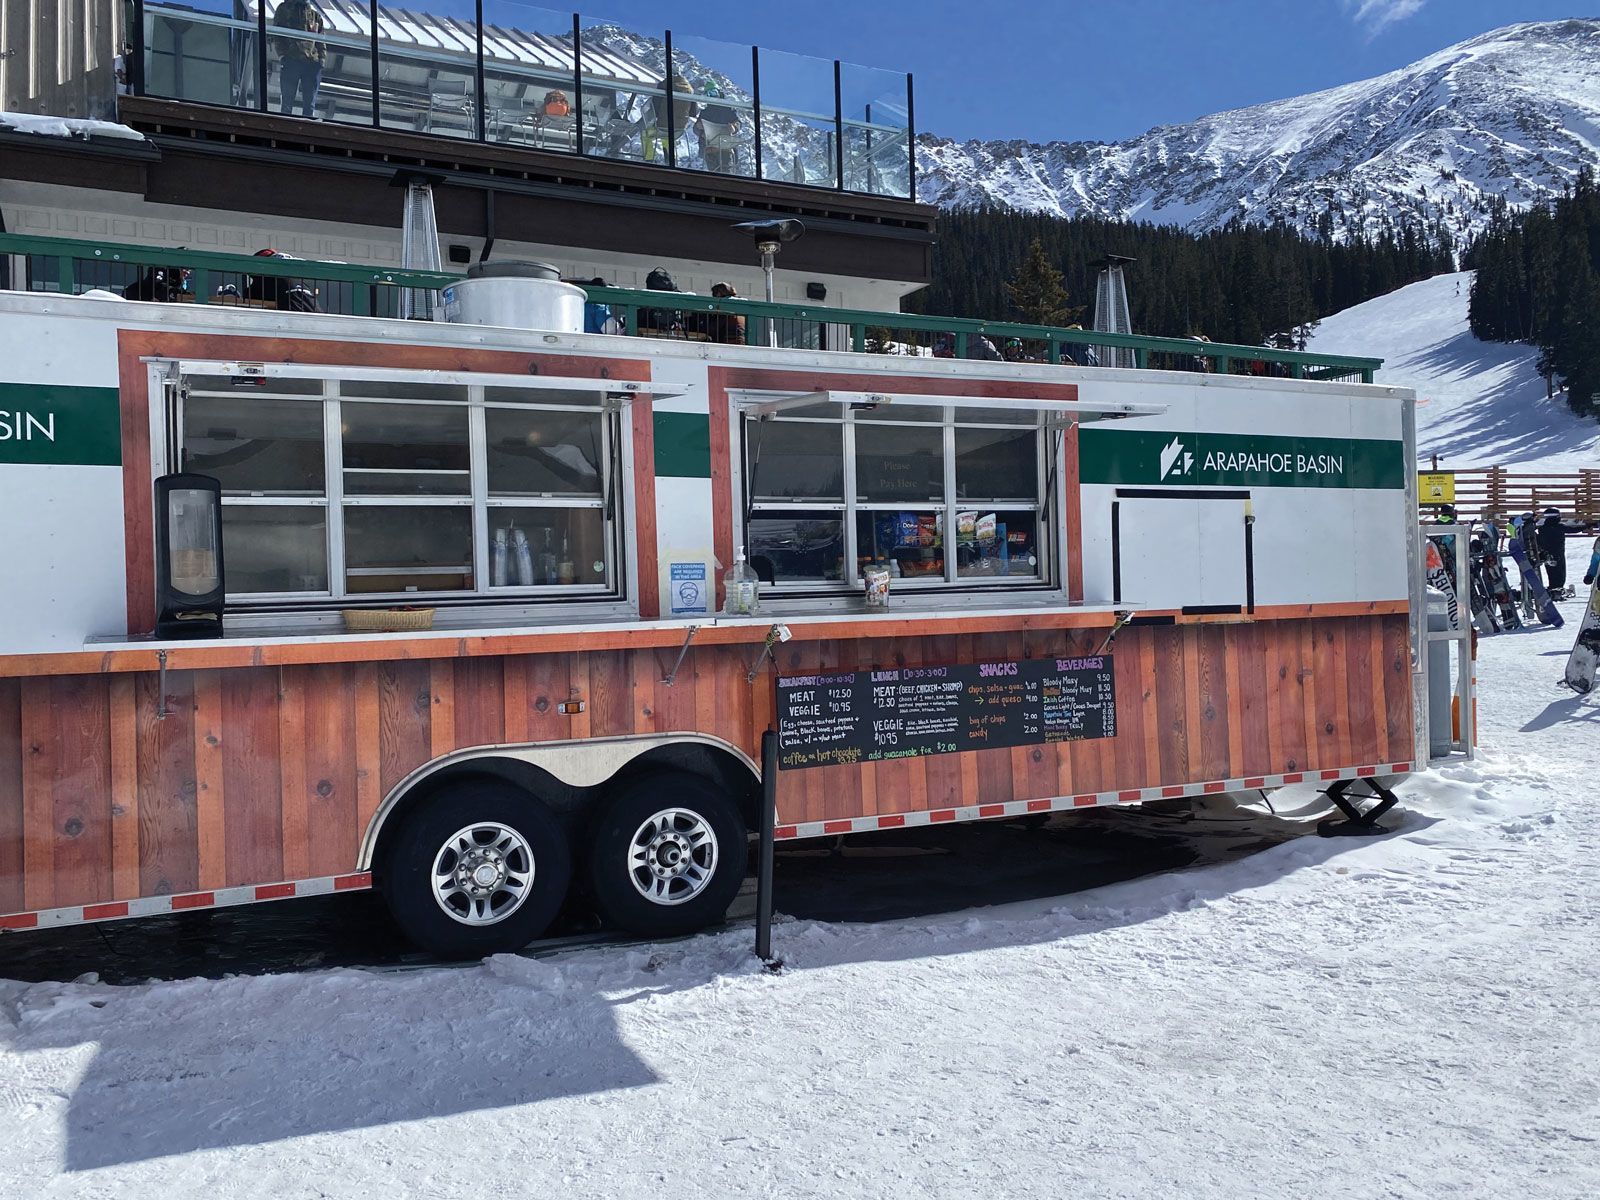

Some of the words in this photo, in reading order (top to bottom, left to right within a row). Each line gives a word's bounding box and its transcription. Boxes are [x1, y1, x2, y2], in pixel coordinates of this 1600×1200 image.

[1203, 451, 1292, 473] ARAPAHOE
[1297, 454, 1343, 475] BASIN
[979, 662, 1018, 677] SNACKS
[1056, 656, 1104, 672] BEVERAGES
[870, 670, 899, 682] LUNCH
[1043, 677, 1062, 689] Bloody
[789, 690, 816, 703] MEAT
[988, 695, 999, 704] add
[1001, 696, 1022, 707] queso
[789, 704, 821, 717] VEGGIE
[828, 701, 851, 712] $10.95
[873, 719, 904, 732] VEGGIE
[969, 716, 980, 728] bag
[968, 727, 988, 741] candy
[783, 751, 808, 765] coffee
[868, 749, 882, 760] add
